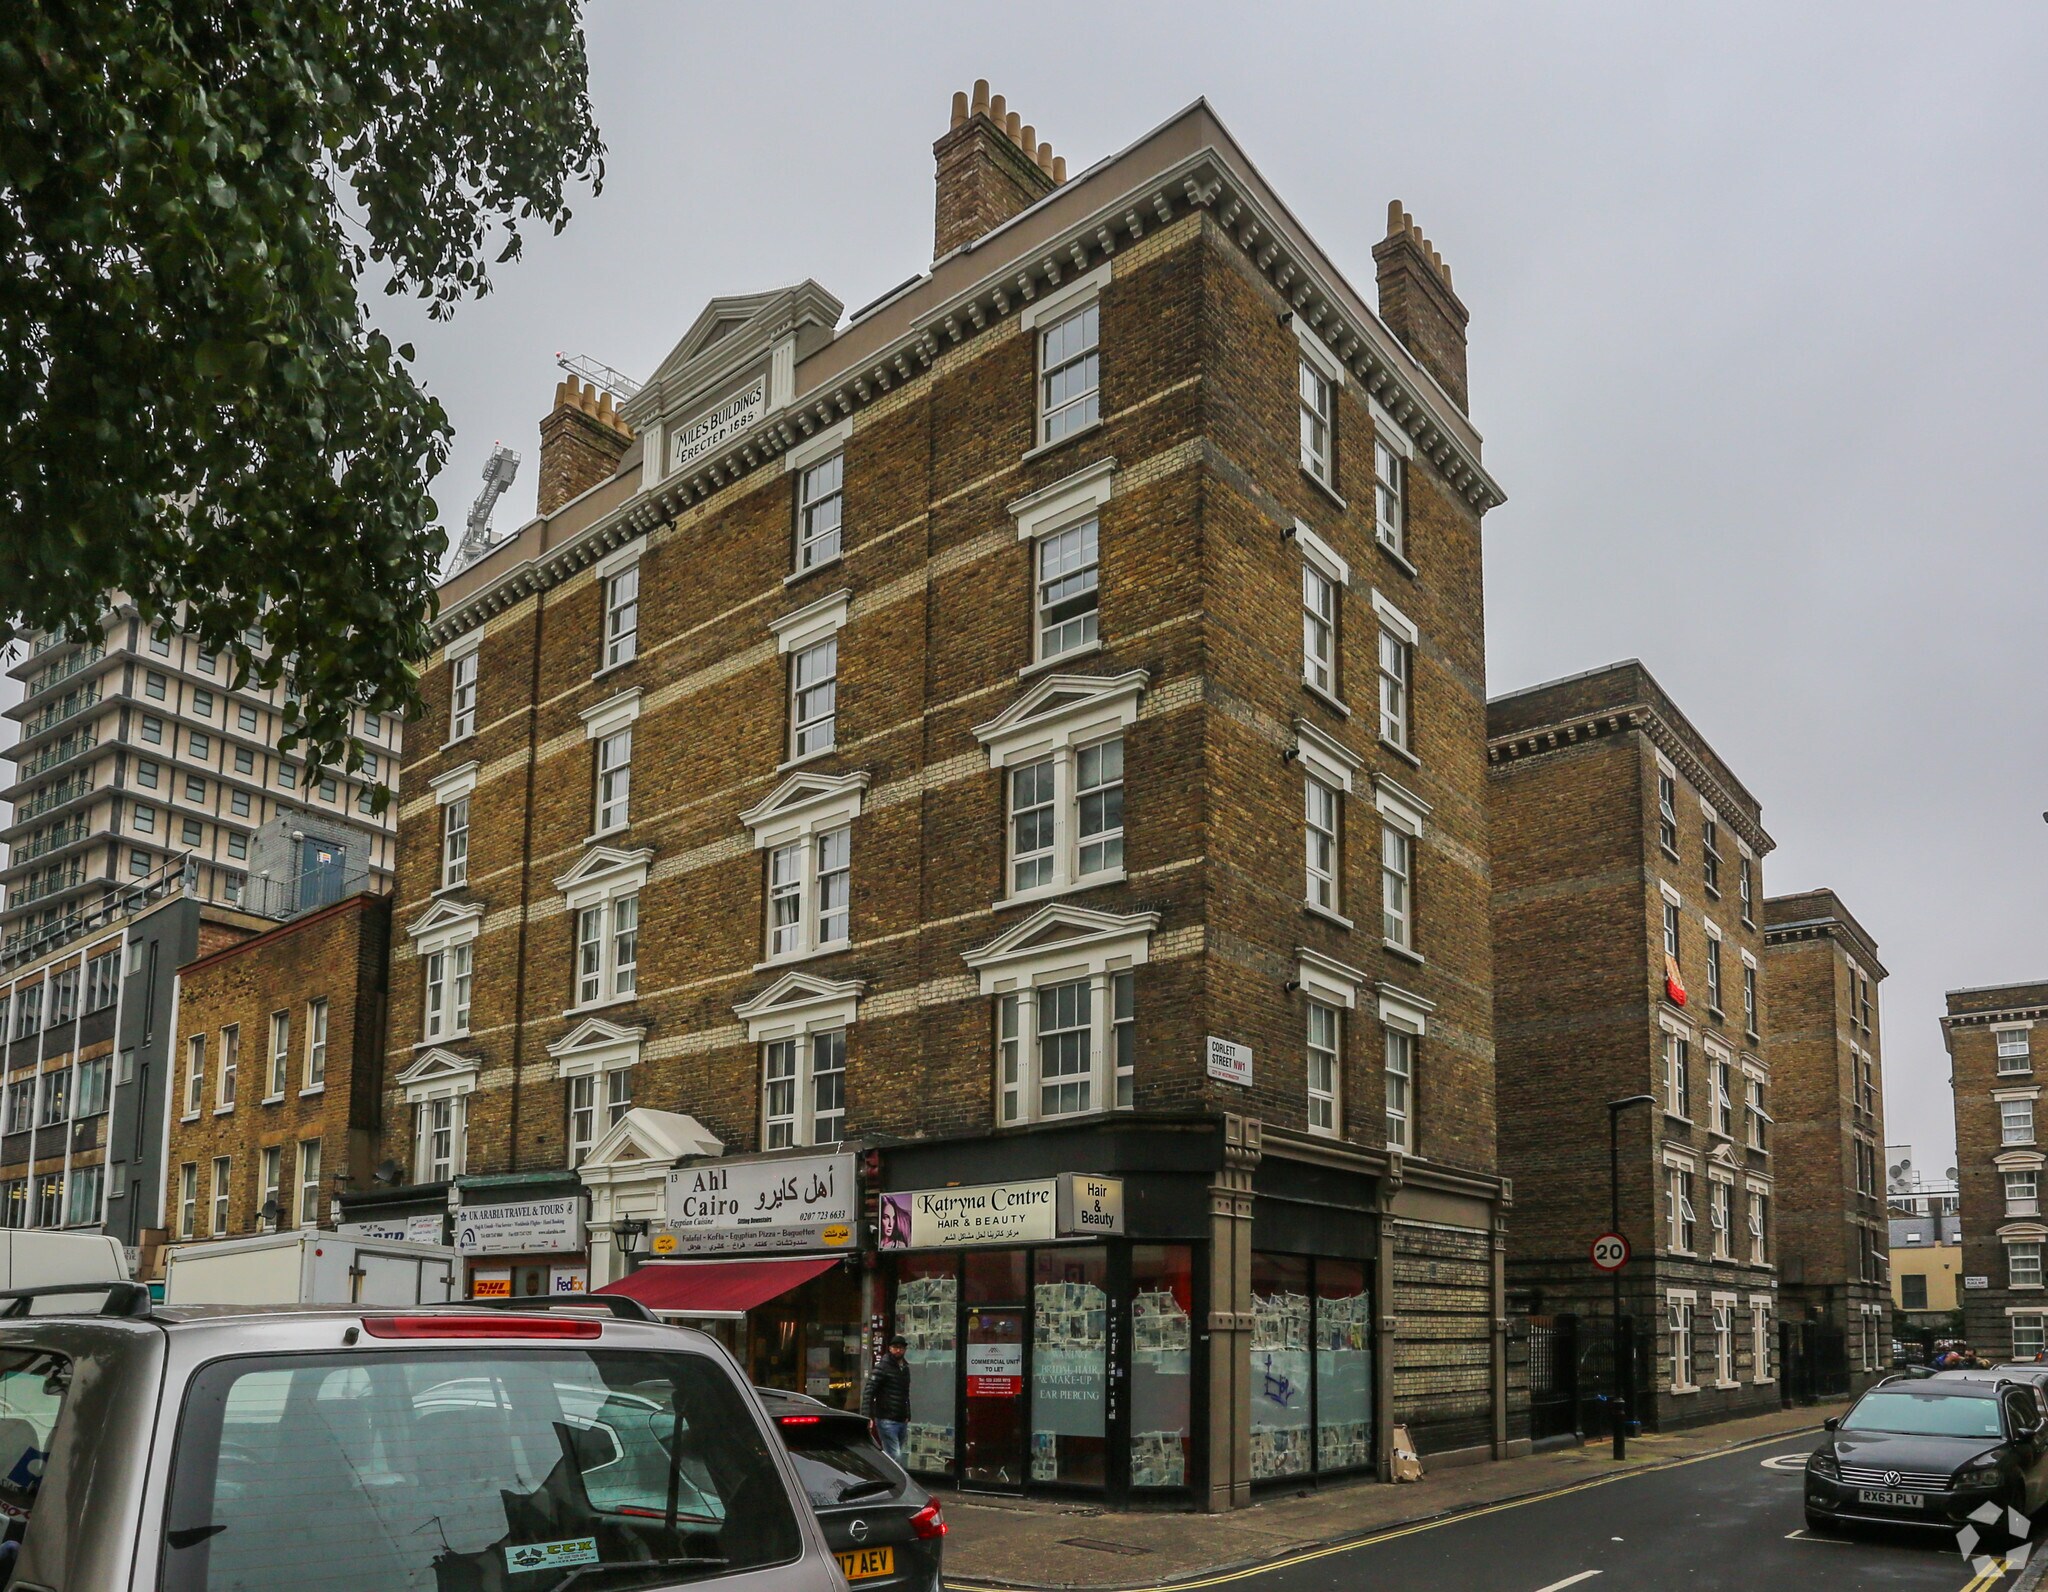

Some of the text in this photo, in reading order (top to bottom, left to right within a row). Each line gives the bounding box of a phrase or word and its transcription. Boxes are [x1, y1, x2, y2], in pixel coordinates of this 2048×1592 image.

[676, 386, 762, 457] MILES BUILDINGS
[681, 411, 754, 463] ERECTED 1885
[1212, 1041, 1236, 1057] CORLETT
[1212, 1054, 1246, 1072] STREET NW1
[671, 1174, 678, 1183] 13
[692, 1169, 728, 1193] Ahl
[754, 1164, 834, 1211] أهل كايرو
[1087, 1182, 1107, 1197] Hair
[683, 1195, 739, 1218] Cairo
[917, 1188, 1050, 1219] Katryna Centre
[1094, 1199, 1101, 1213] &
[469, 1203, 564, 1221] UK ARABIA TRAVEL & TOURS
[799, 1210, 846, 1221] 0207 723 6633
[1081, 1210, 1115, 1228] Beauty
[670, 1218, 714, 1229] Egyptian Cuisine
[937, 1214, 1026, 1229] HAIR & BEAUTY
[758, 1230, 776, 1238] Pizza
[1006, 1229, 1019, 1238] مركز
[1596, 1244, 1623, 1260] 20
[476, 1282, 506, 1294] DHL
[556, 1275, 584, 1291] FedEx
[1075, 1365, 1098, 1375] HAIR
[1049, 1375, 1092, 1385] MAKE-UP
[1040, 1390, 1099, 1401] EAR PIERCING
[1863, 1490, 1918, 1505] RX63 PLV
[835, 1550, 888, 1576] 17 AEV
